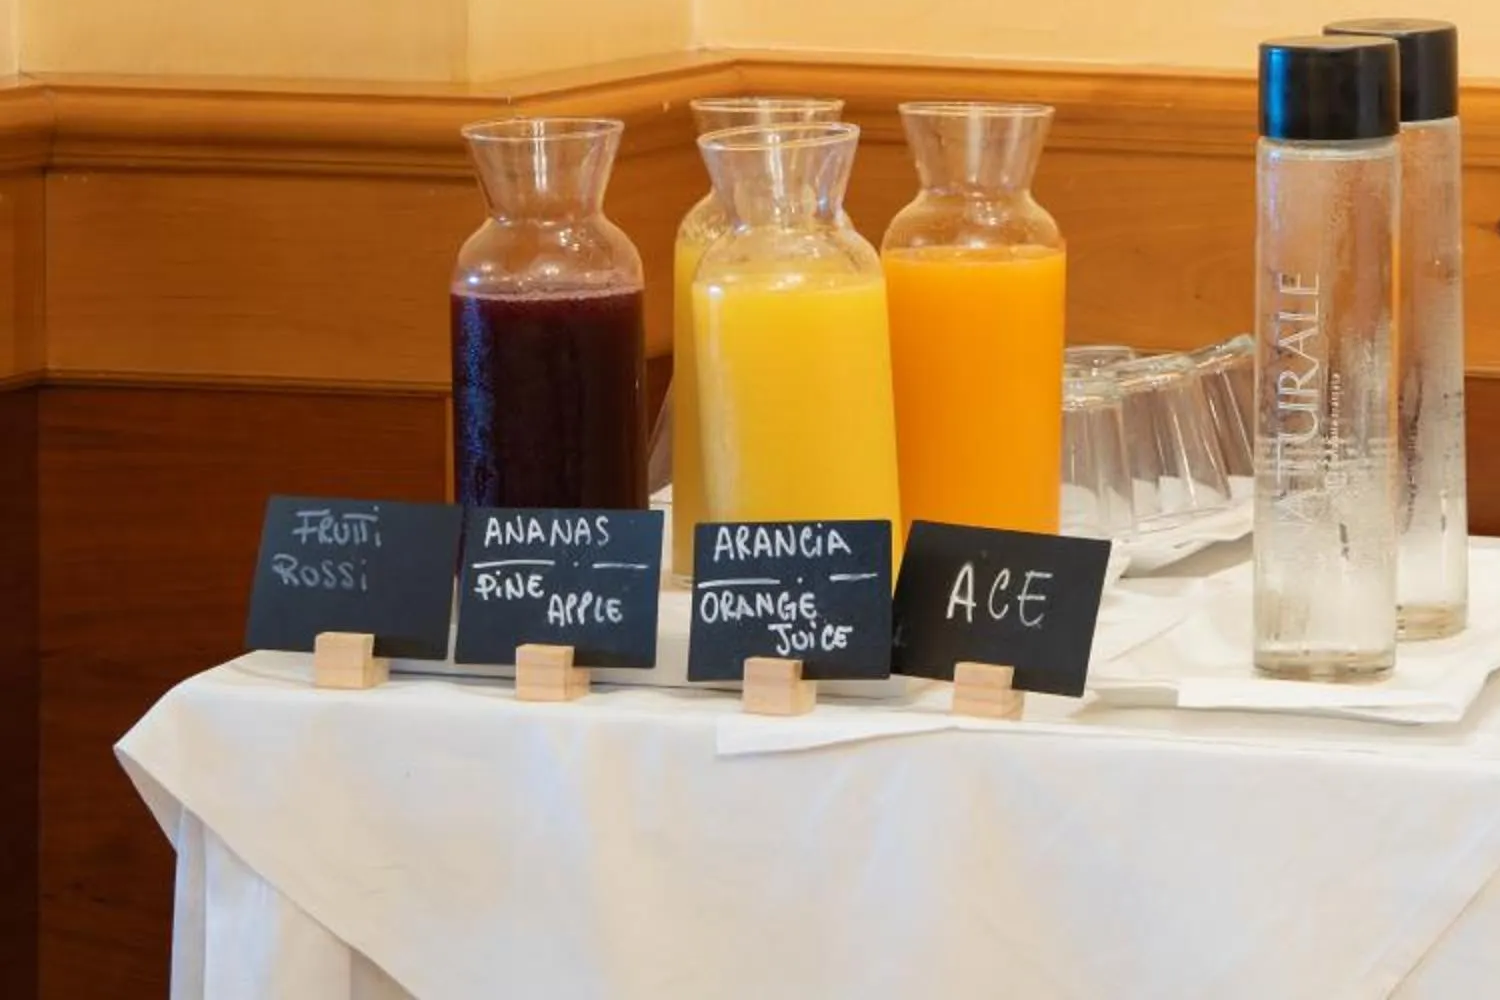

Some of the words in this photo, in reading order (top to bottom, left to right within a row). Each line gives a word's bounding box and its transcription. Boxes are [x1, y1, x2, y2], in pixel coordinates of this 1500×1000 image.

[484, 515, 609, 548] ANANAS
[547, 593, 623, 627] APPLE
[700, 591, 819, 625] ORANGE
[946, 560, 1053, 628] ACE
